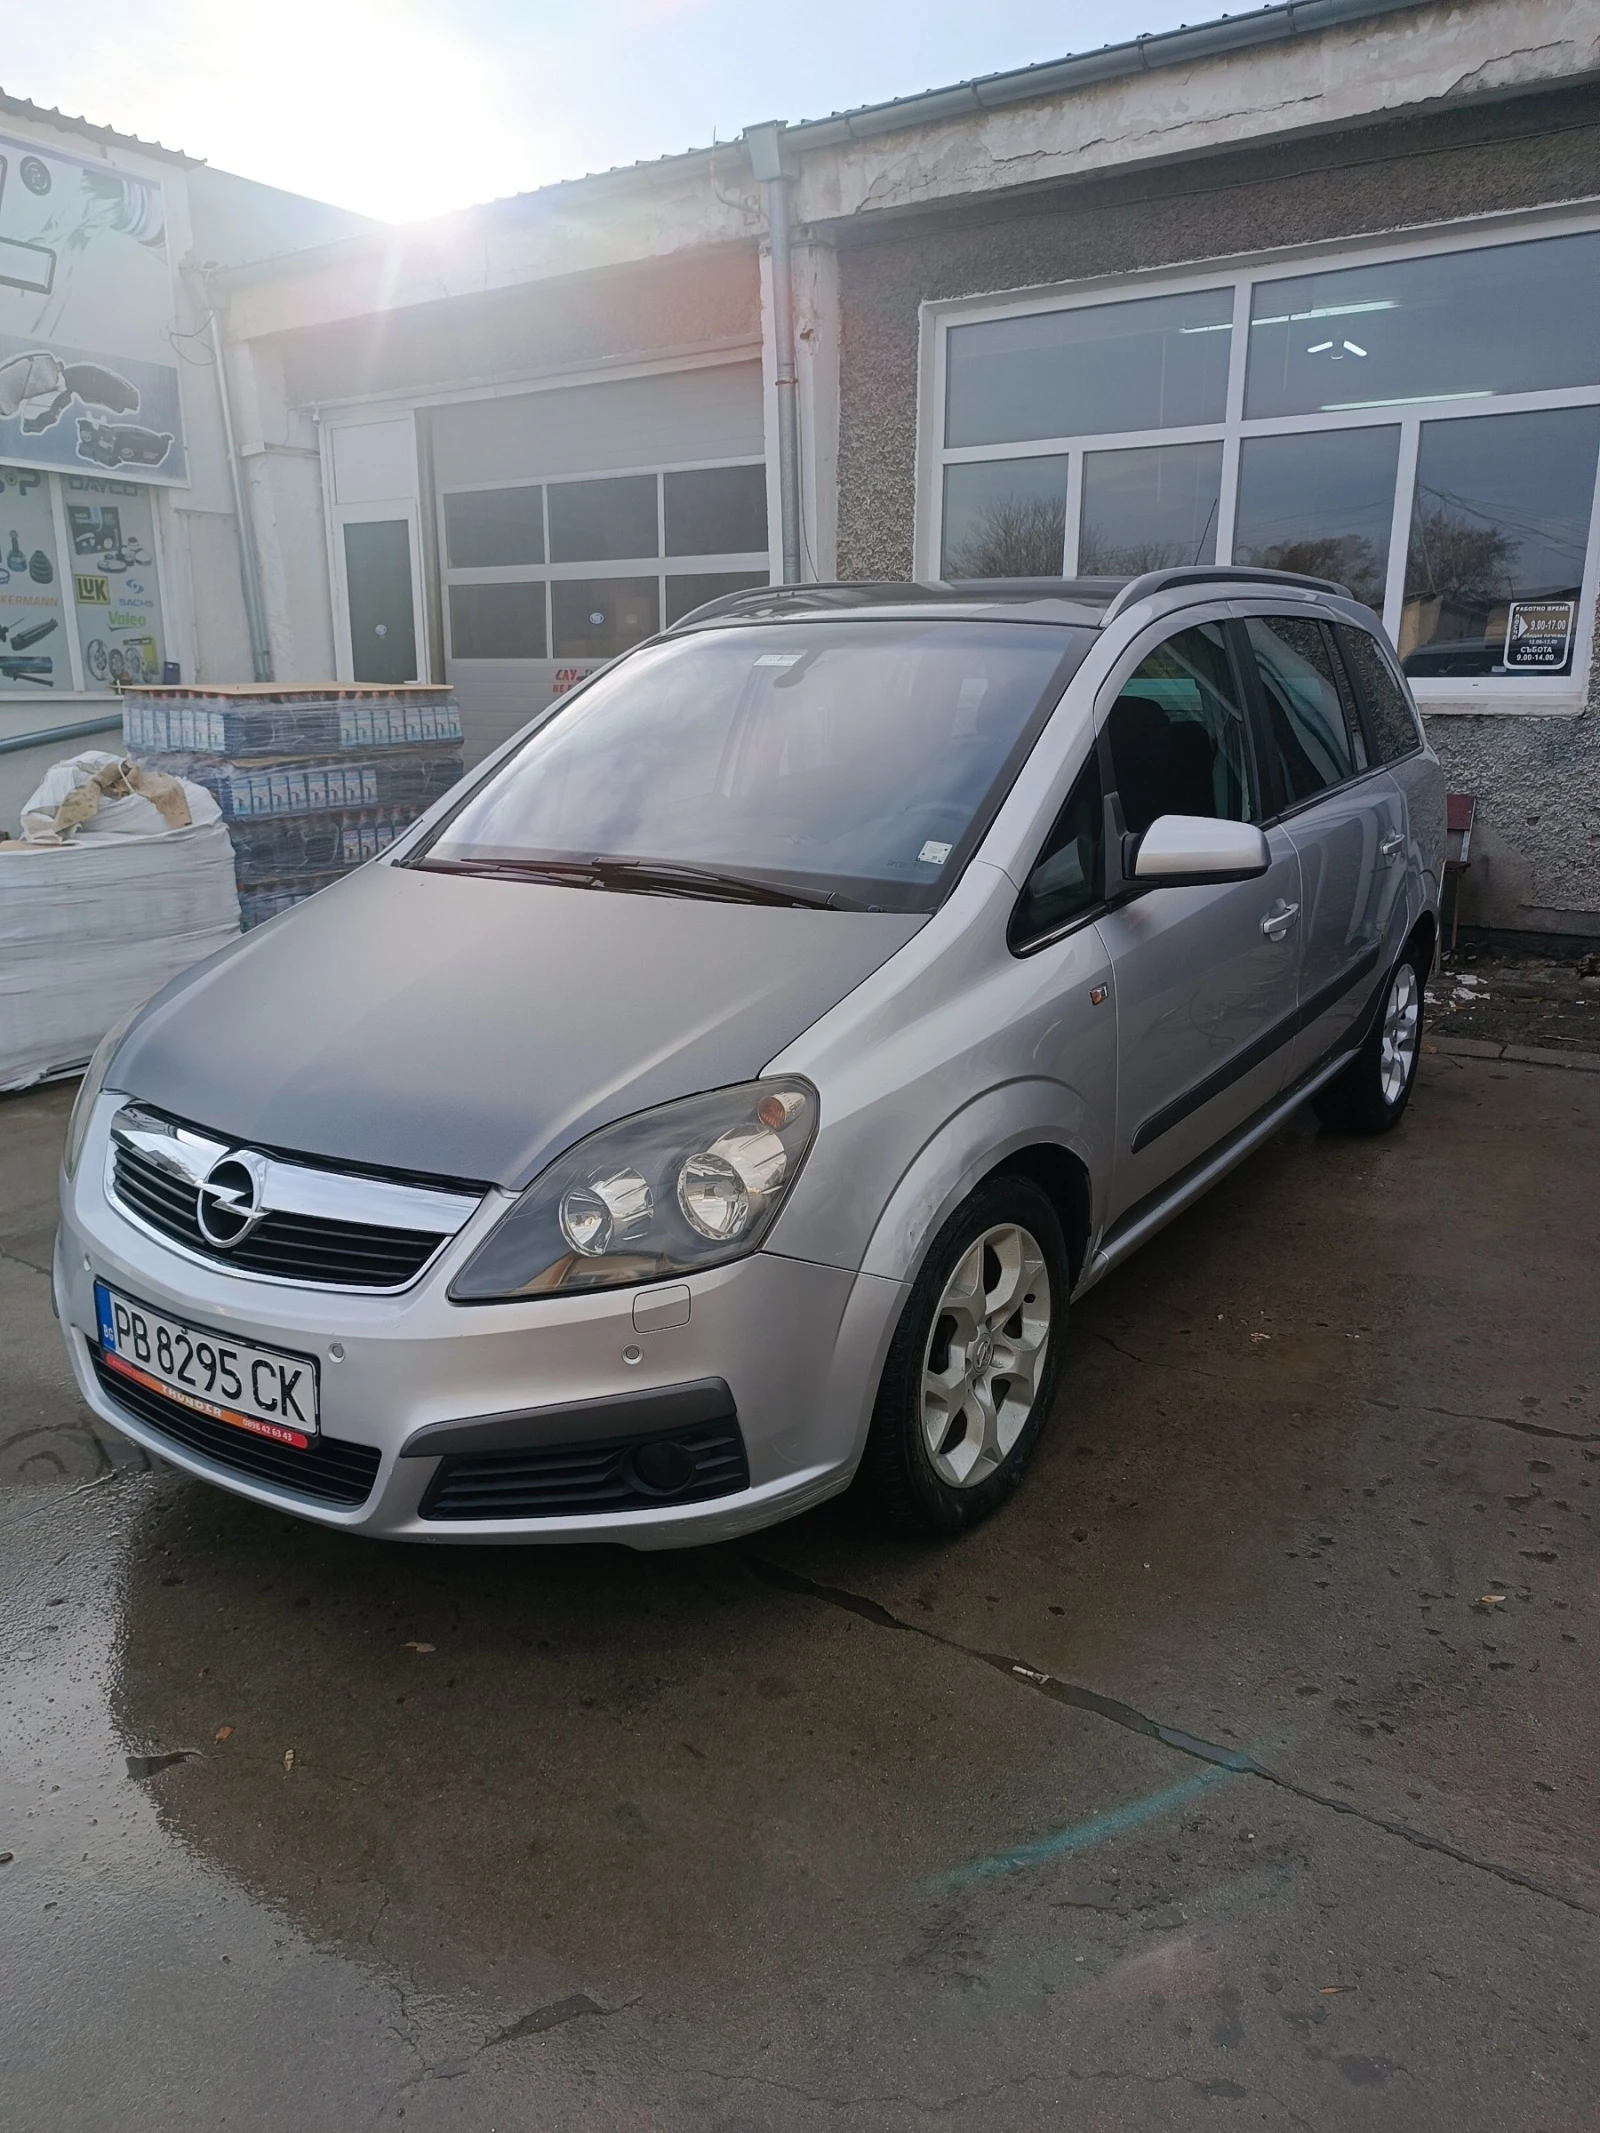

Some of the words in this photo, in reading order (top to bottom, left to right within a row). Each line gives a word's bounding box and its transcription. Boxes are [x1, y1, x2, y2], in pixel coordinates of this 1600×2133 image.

[69, 475, 138, 497] DAYCO
[119, 598, 154, 608] SACHS
[103, 1323, 114, 1341] BG
[161, 1384, 222, 1417] THUNDER
